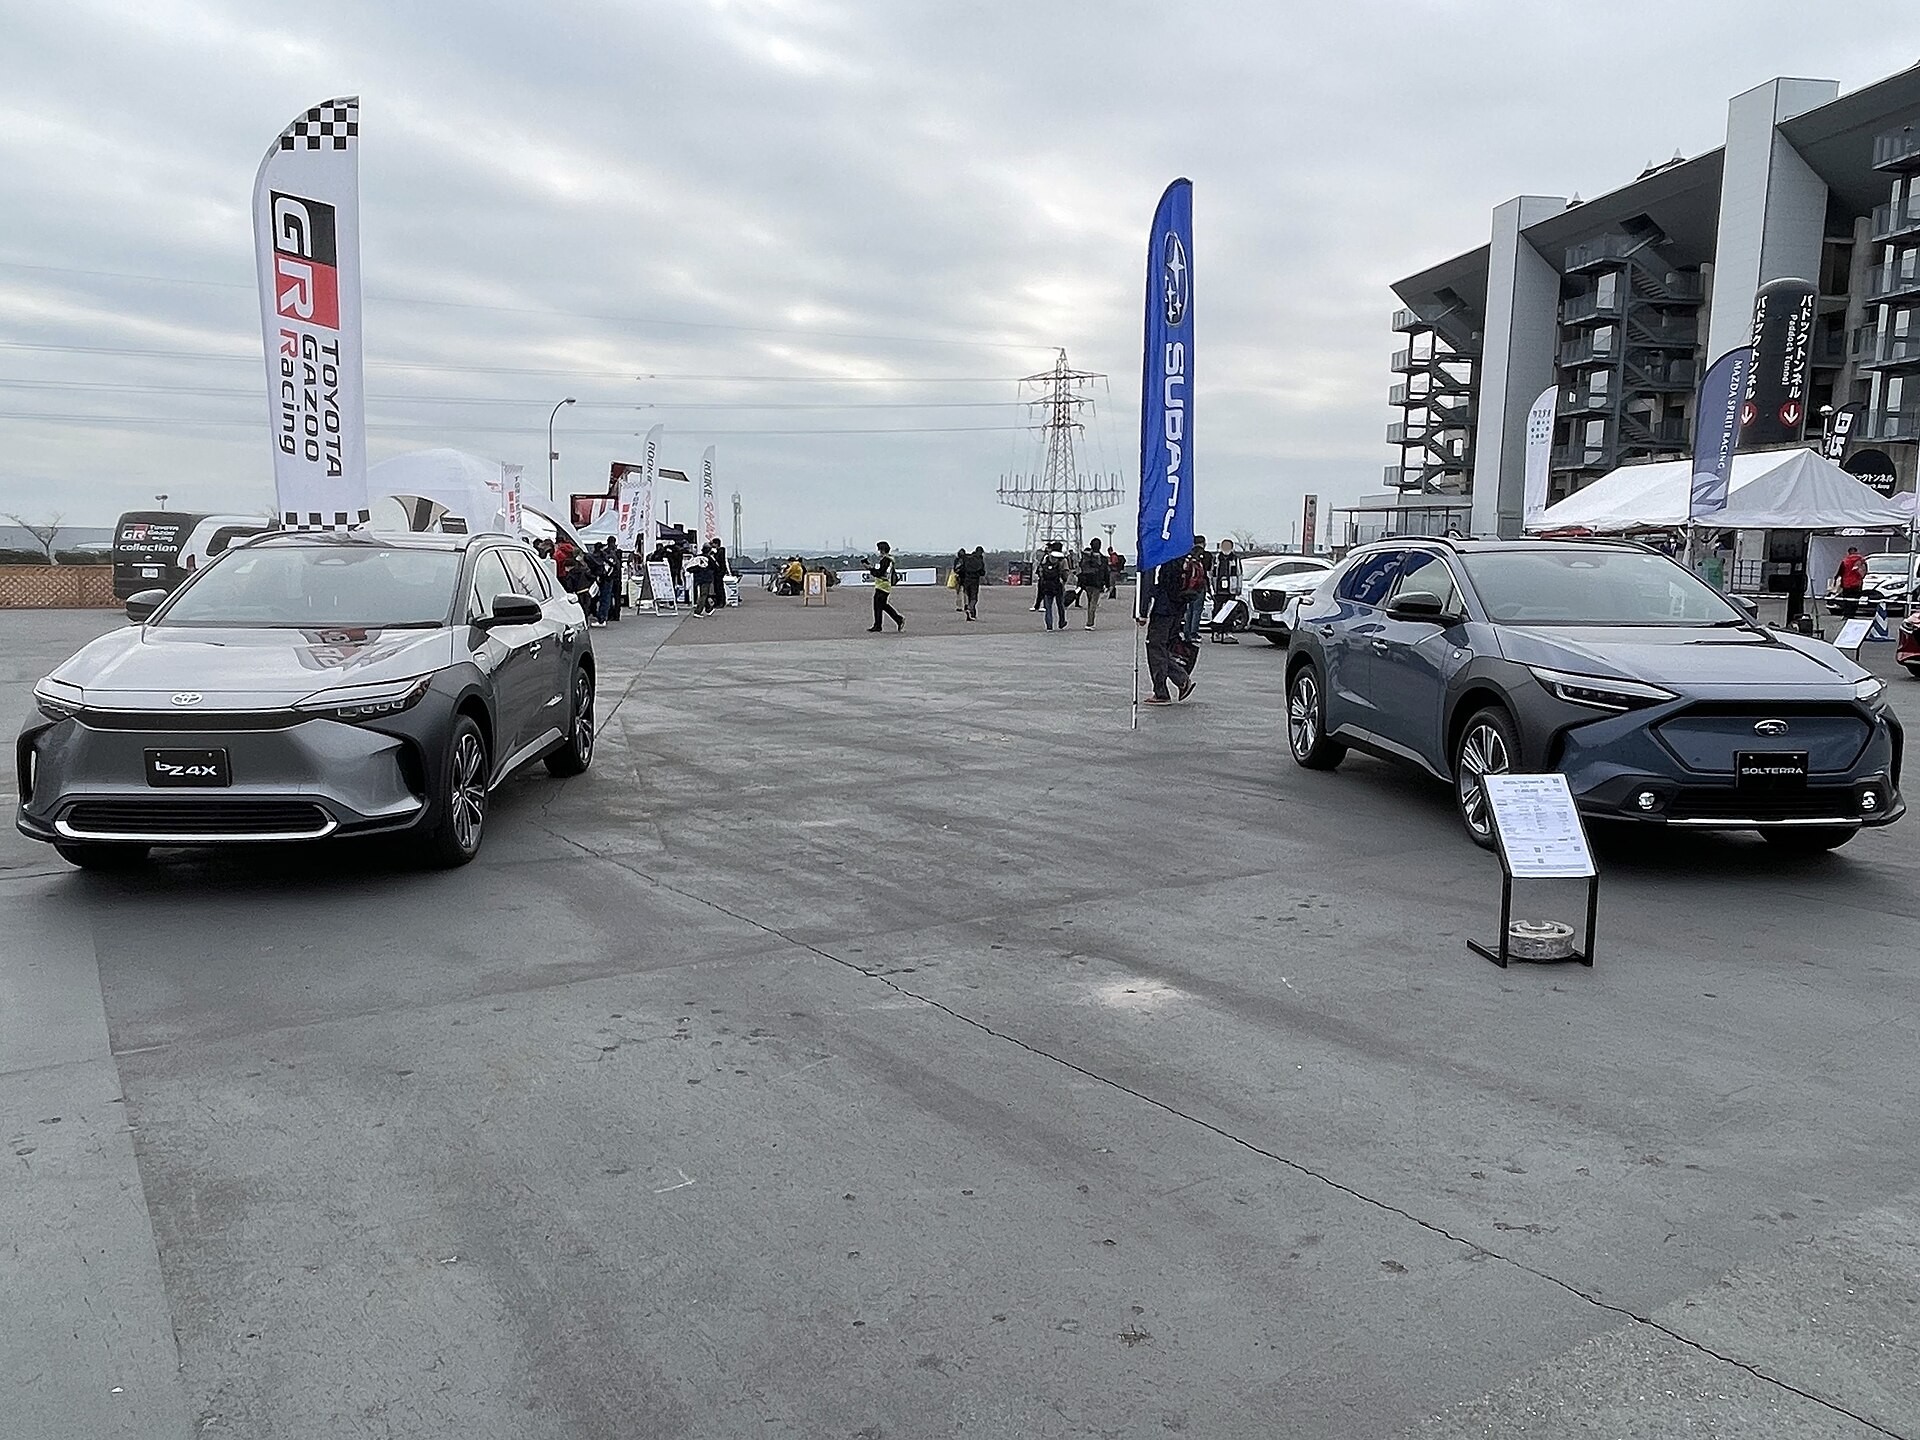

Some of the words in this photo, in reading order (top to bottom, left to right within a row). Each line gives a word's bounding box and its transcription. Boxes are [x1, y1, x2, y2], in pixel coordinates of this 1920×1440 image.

[274, 196, 315, 319] GR
[1727, 359, 1743, 397] MAZDA
[1781, 354, 1794, 386] Tunnel
[278, 328, 300, 455] Racing
[302, 333, 320, 462] GAZOO
[321, 338, 342, 477] TOYOTA
[1721, 399, 1738, 430] SPIRIT
[1717, 431, 1731, 470] RACING
[703, 459, 713, 500] ROOKIE
[119, 543, 178, 552] collection
[1741, 767, 1804, 775] SOLTERRA
